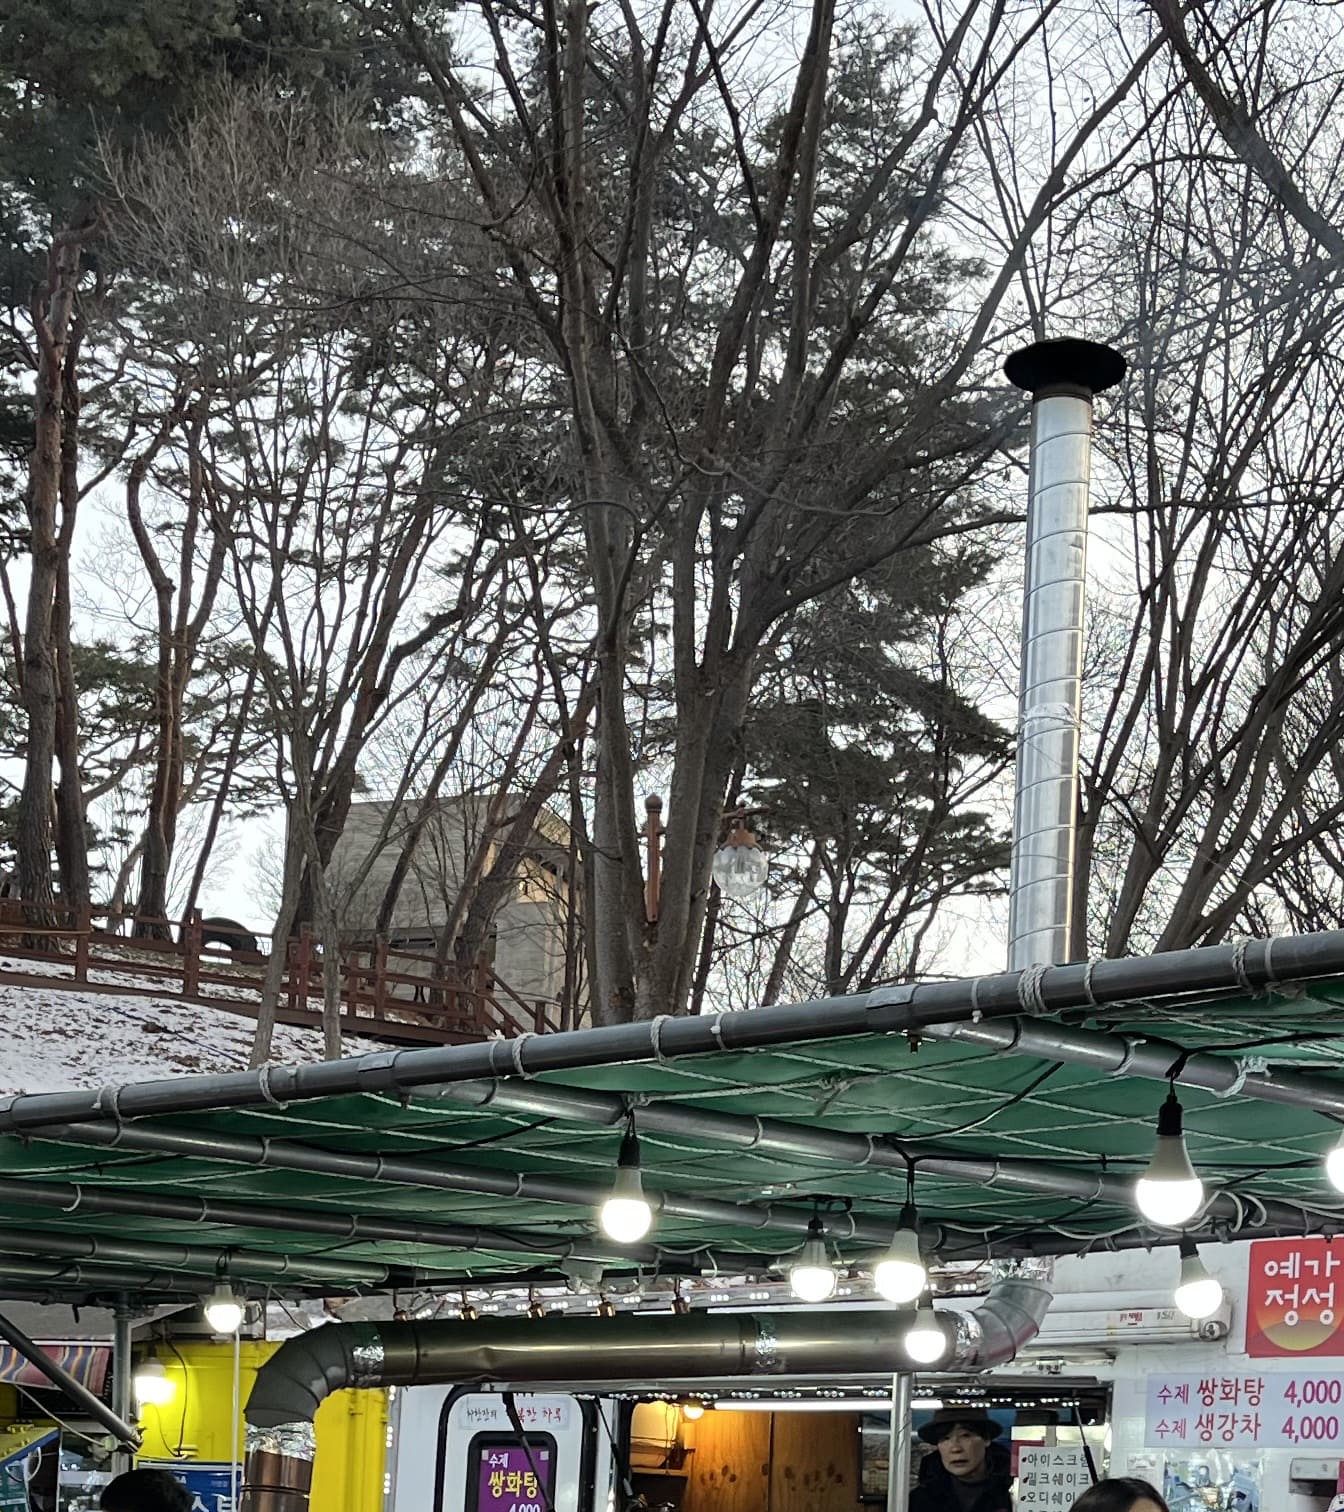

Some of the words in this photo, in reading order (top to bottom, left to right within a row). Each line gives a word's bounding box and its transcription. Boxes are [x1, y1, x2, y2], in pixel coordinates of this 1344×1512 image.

[1264, 1250, 1341, 1279] 예가
[1264, 1288, 1339, 1329] 정성
[1156, 1383, 1190, 1405] 수제
[1196, 1377, 1265, 1407] 쌍화탕
[1283, 1379, 1342, 1409] 4,000
[1154, 1417, 1187, 1440] 수제
[1194, 1412, 1262, 1442] 생강차
[1281, 1415, 1339, 1444] 4,000
[487, 1470, 538, 1499] 쌍화탕
